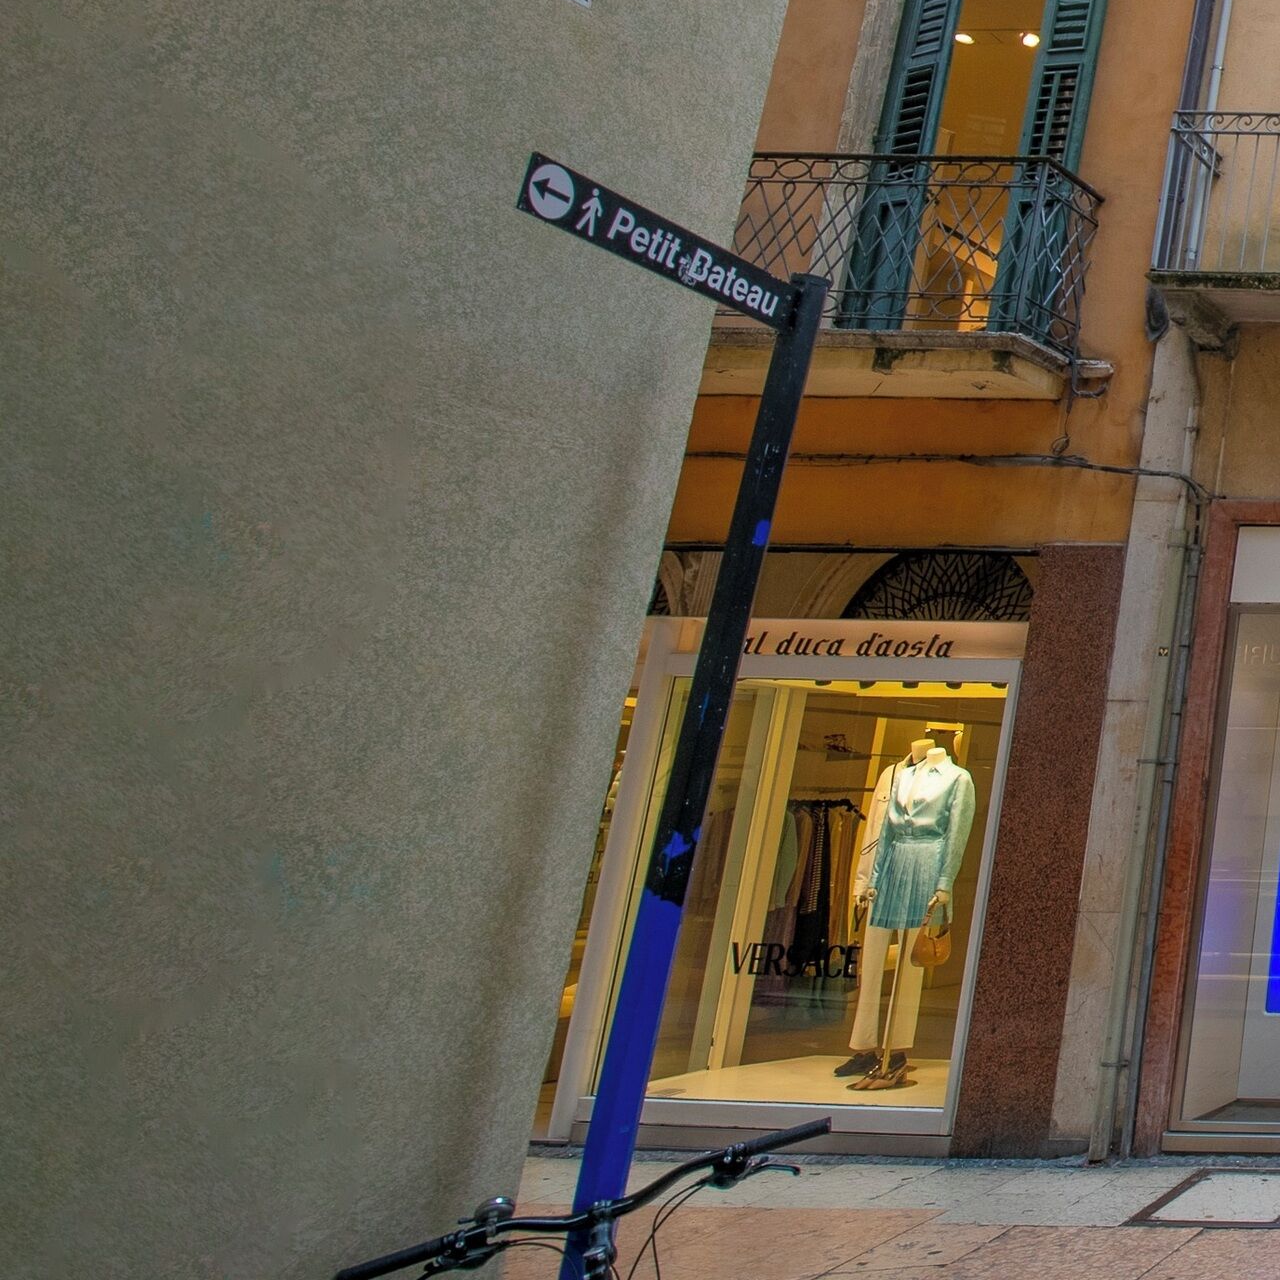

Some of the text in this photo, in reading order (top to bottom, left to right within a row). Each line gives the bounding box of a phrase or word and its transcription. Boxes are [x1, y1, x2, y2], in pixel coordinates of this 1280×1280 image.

[775, 632, 845, 656] duca
[856, 632, 954, 658] d'aosta
[732, 942, 862, 978] VERSACE
